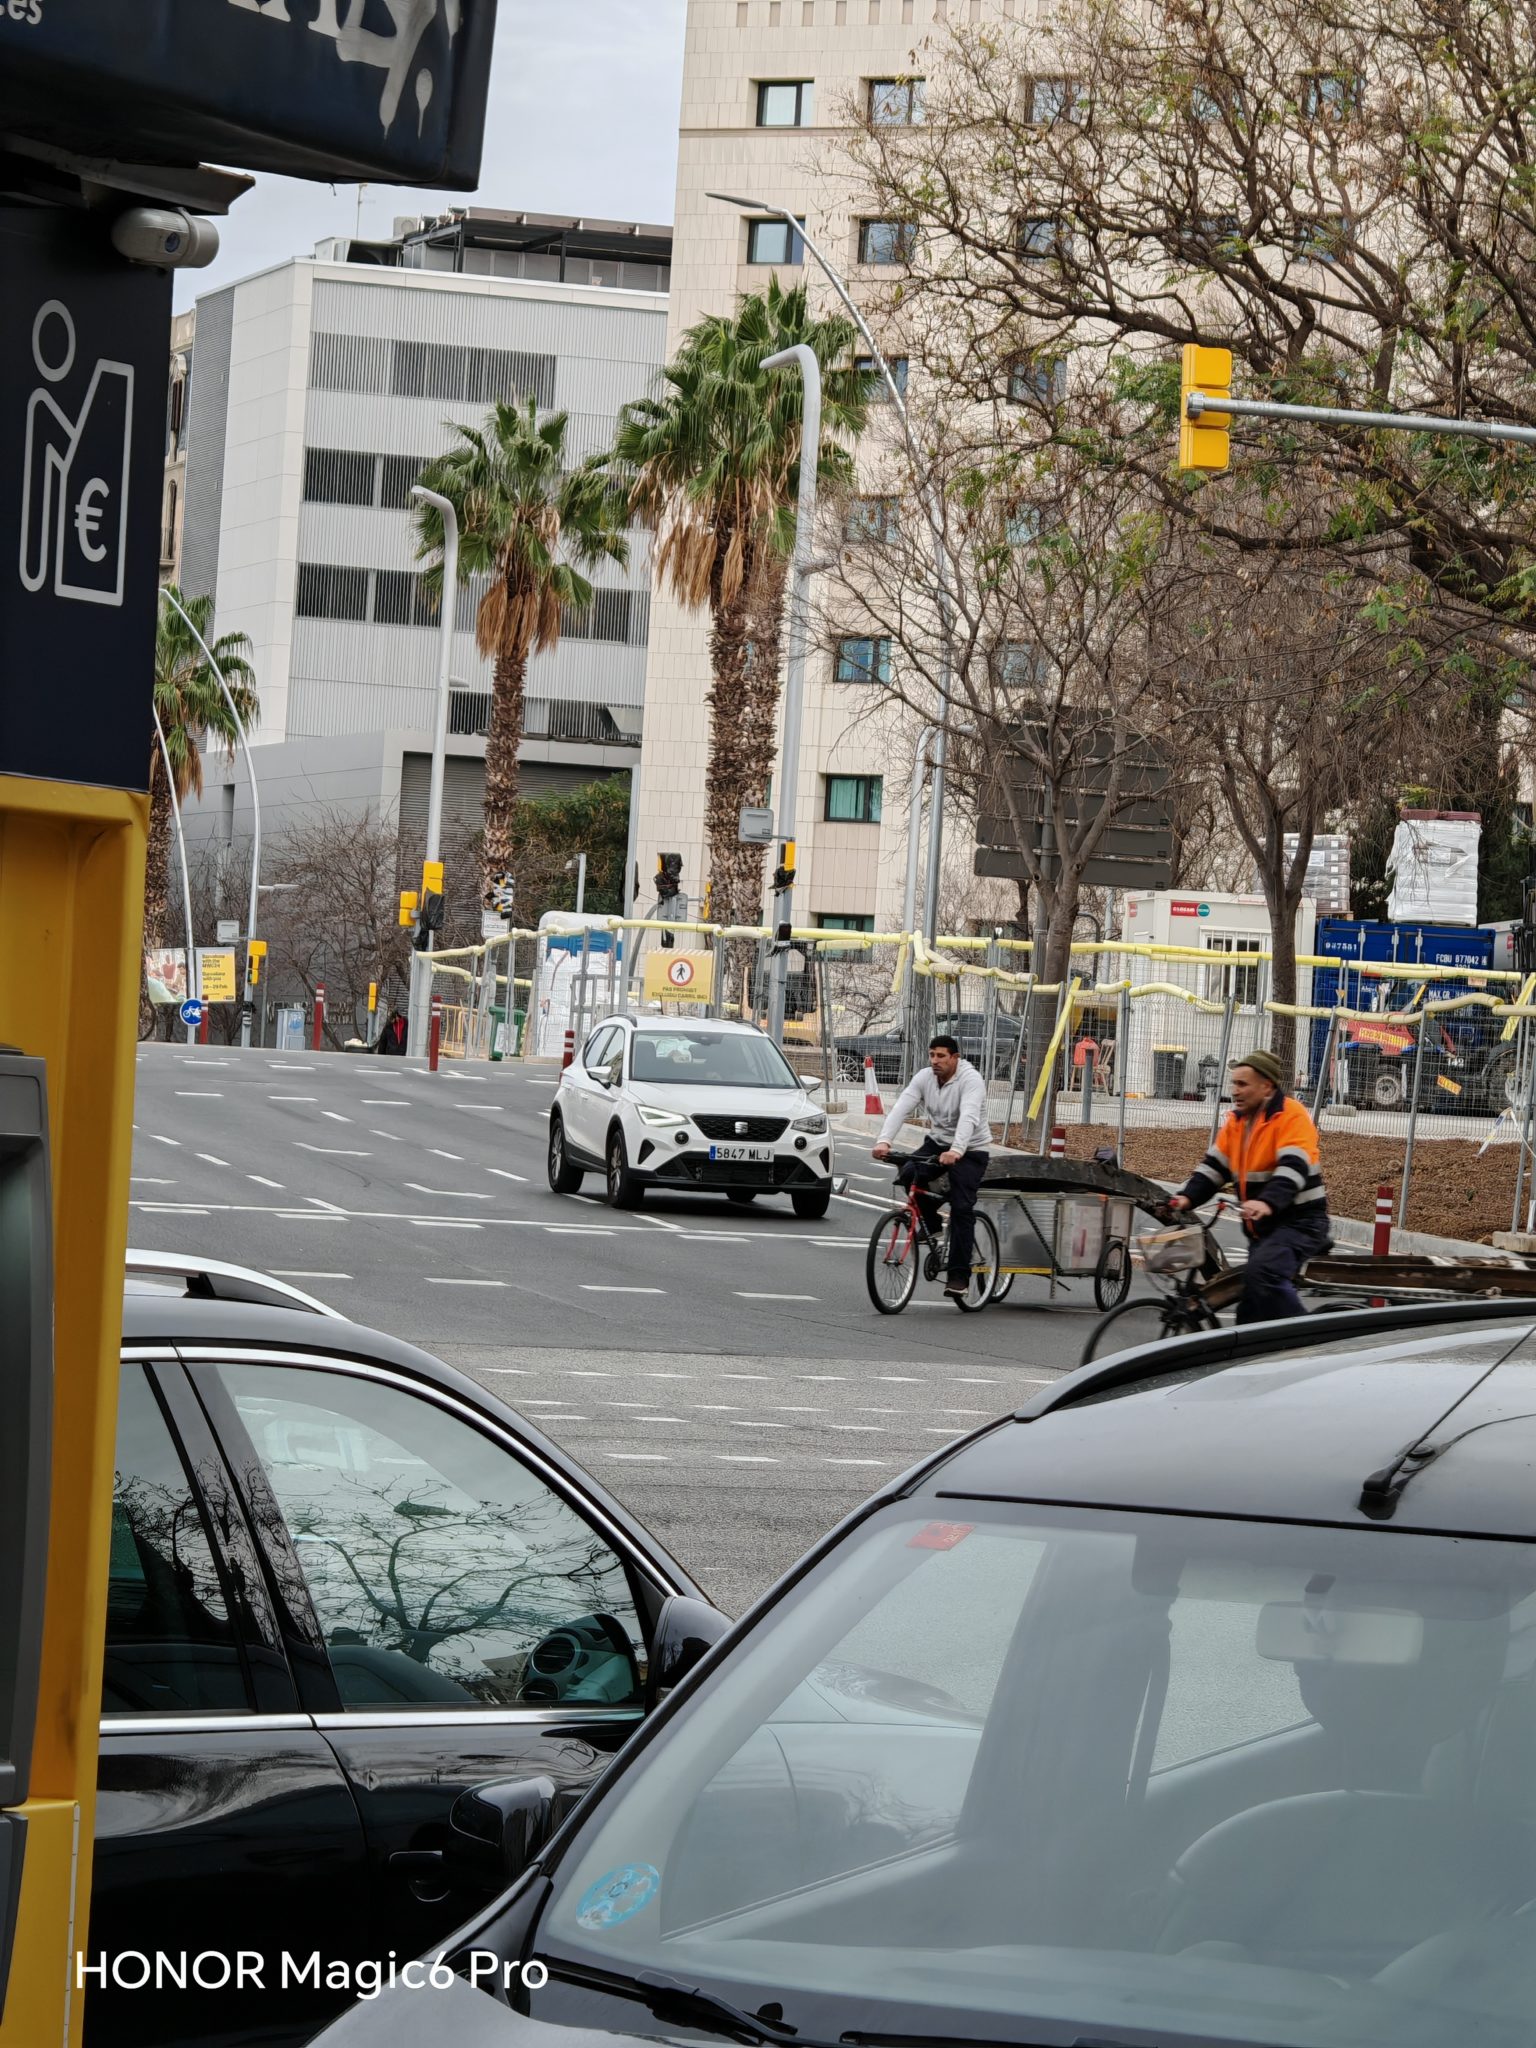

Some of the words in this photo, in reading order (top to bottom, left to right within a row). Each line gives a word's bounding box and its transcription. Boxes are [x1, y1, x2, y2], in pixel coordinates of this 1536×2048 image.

[0, 0, 42, 25] es
[716, 1147, 745, 1159] 5847
[748, 1148, 771, 1160] MLJ
